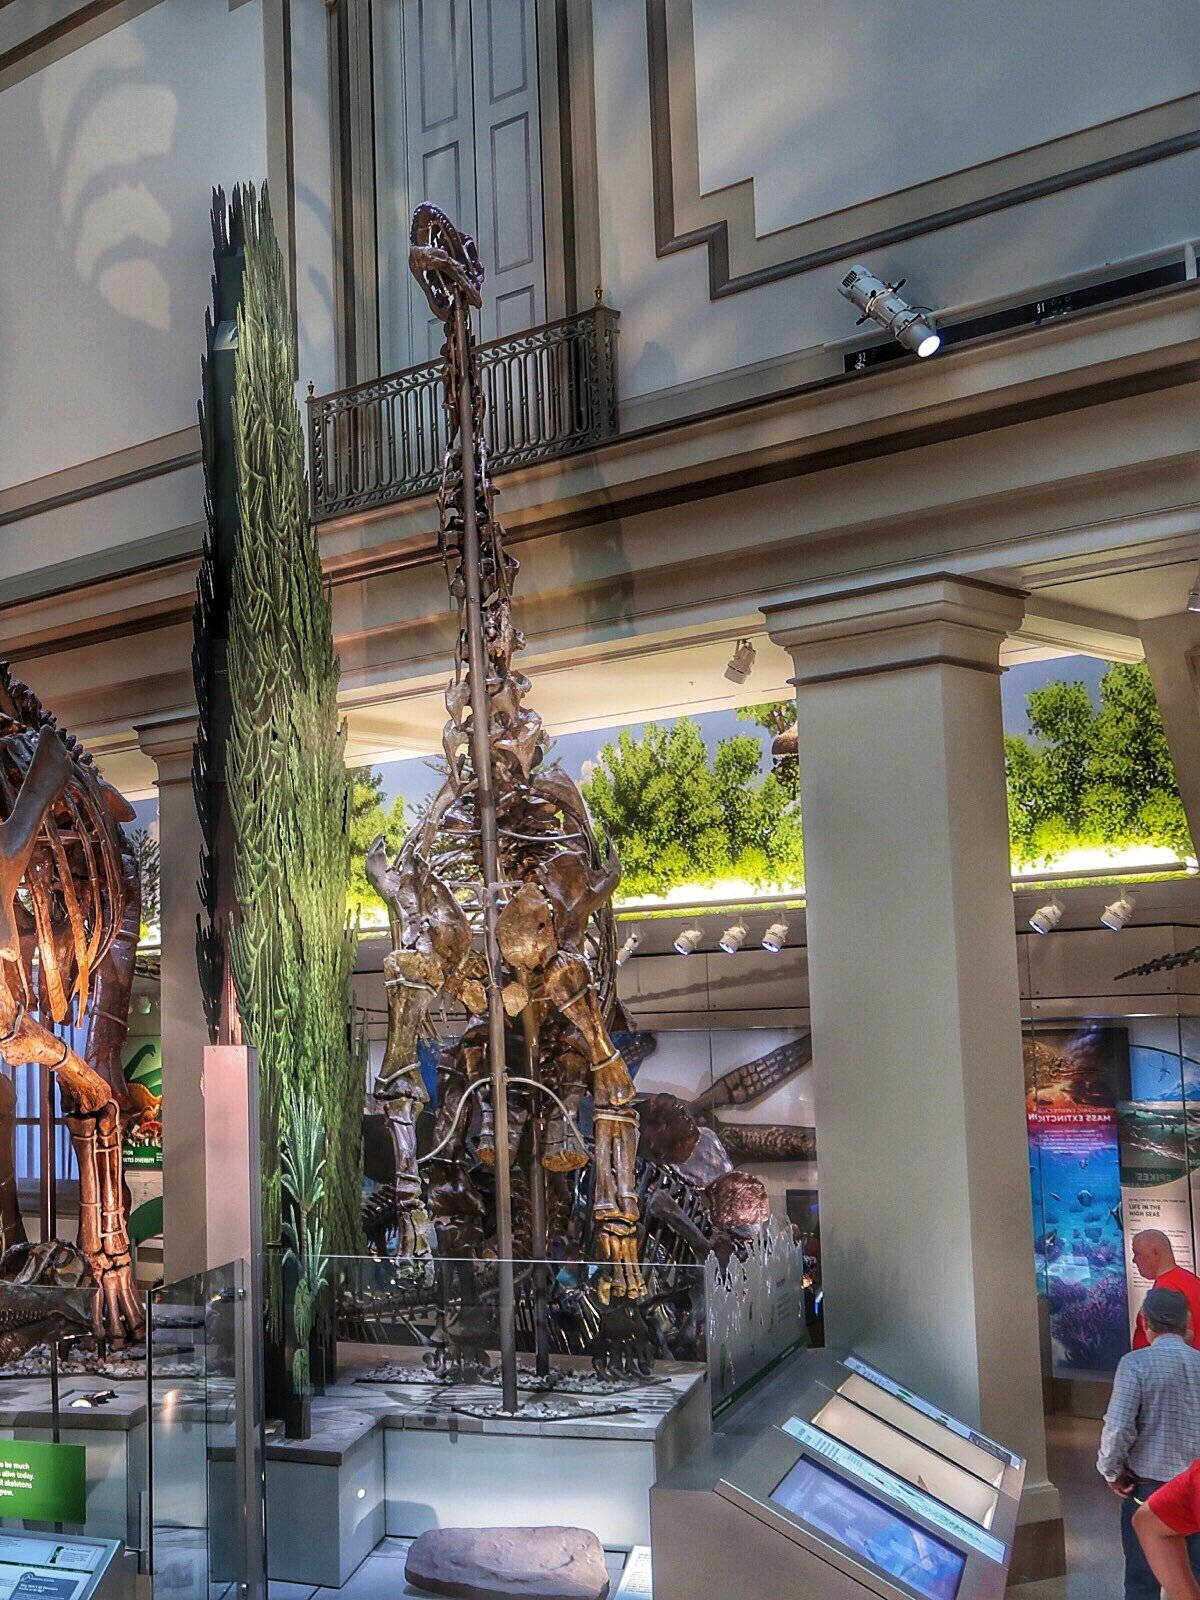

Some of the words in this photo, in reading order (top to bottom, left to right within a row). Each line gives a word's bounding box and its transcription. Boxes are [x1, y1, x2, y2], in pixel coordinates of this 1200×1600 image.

[4, 1460, 12, 1468] be
[13, 1462, 30, 1470] much
[4, 1479, 33, 1489] skeletons
